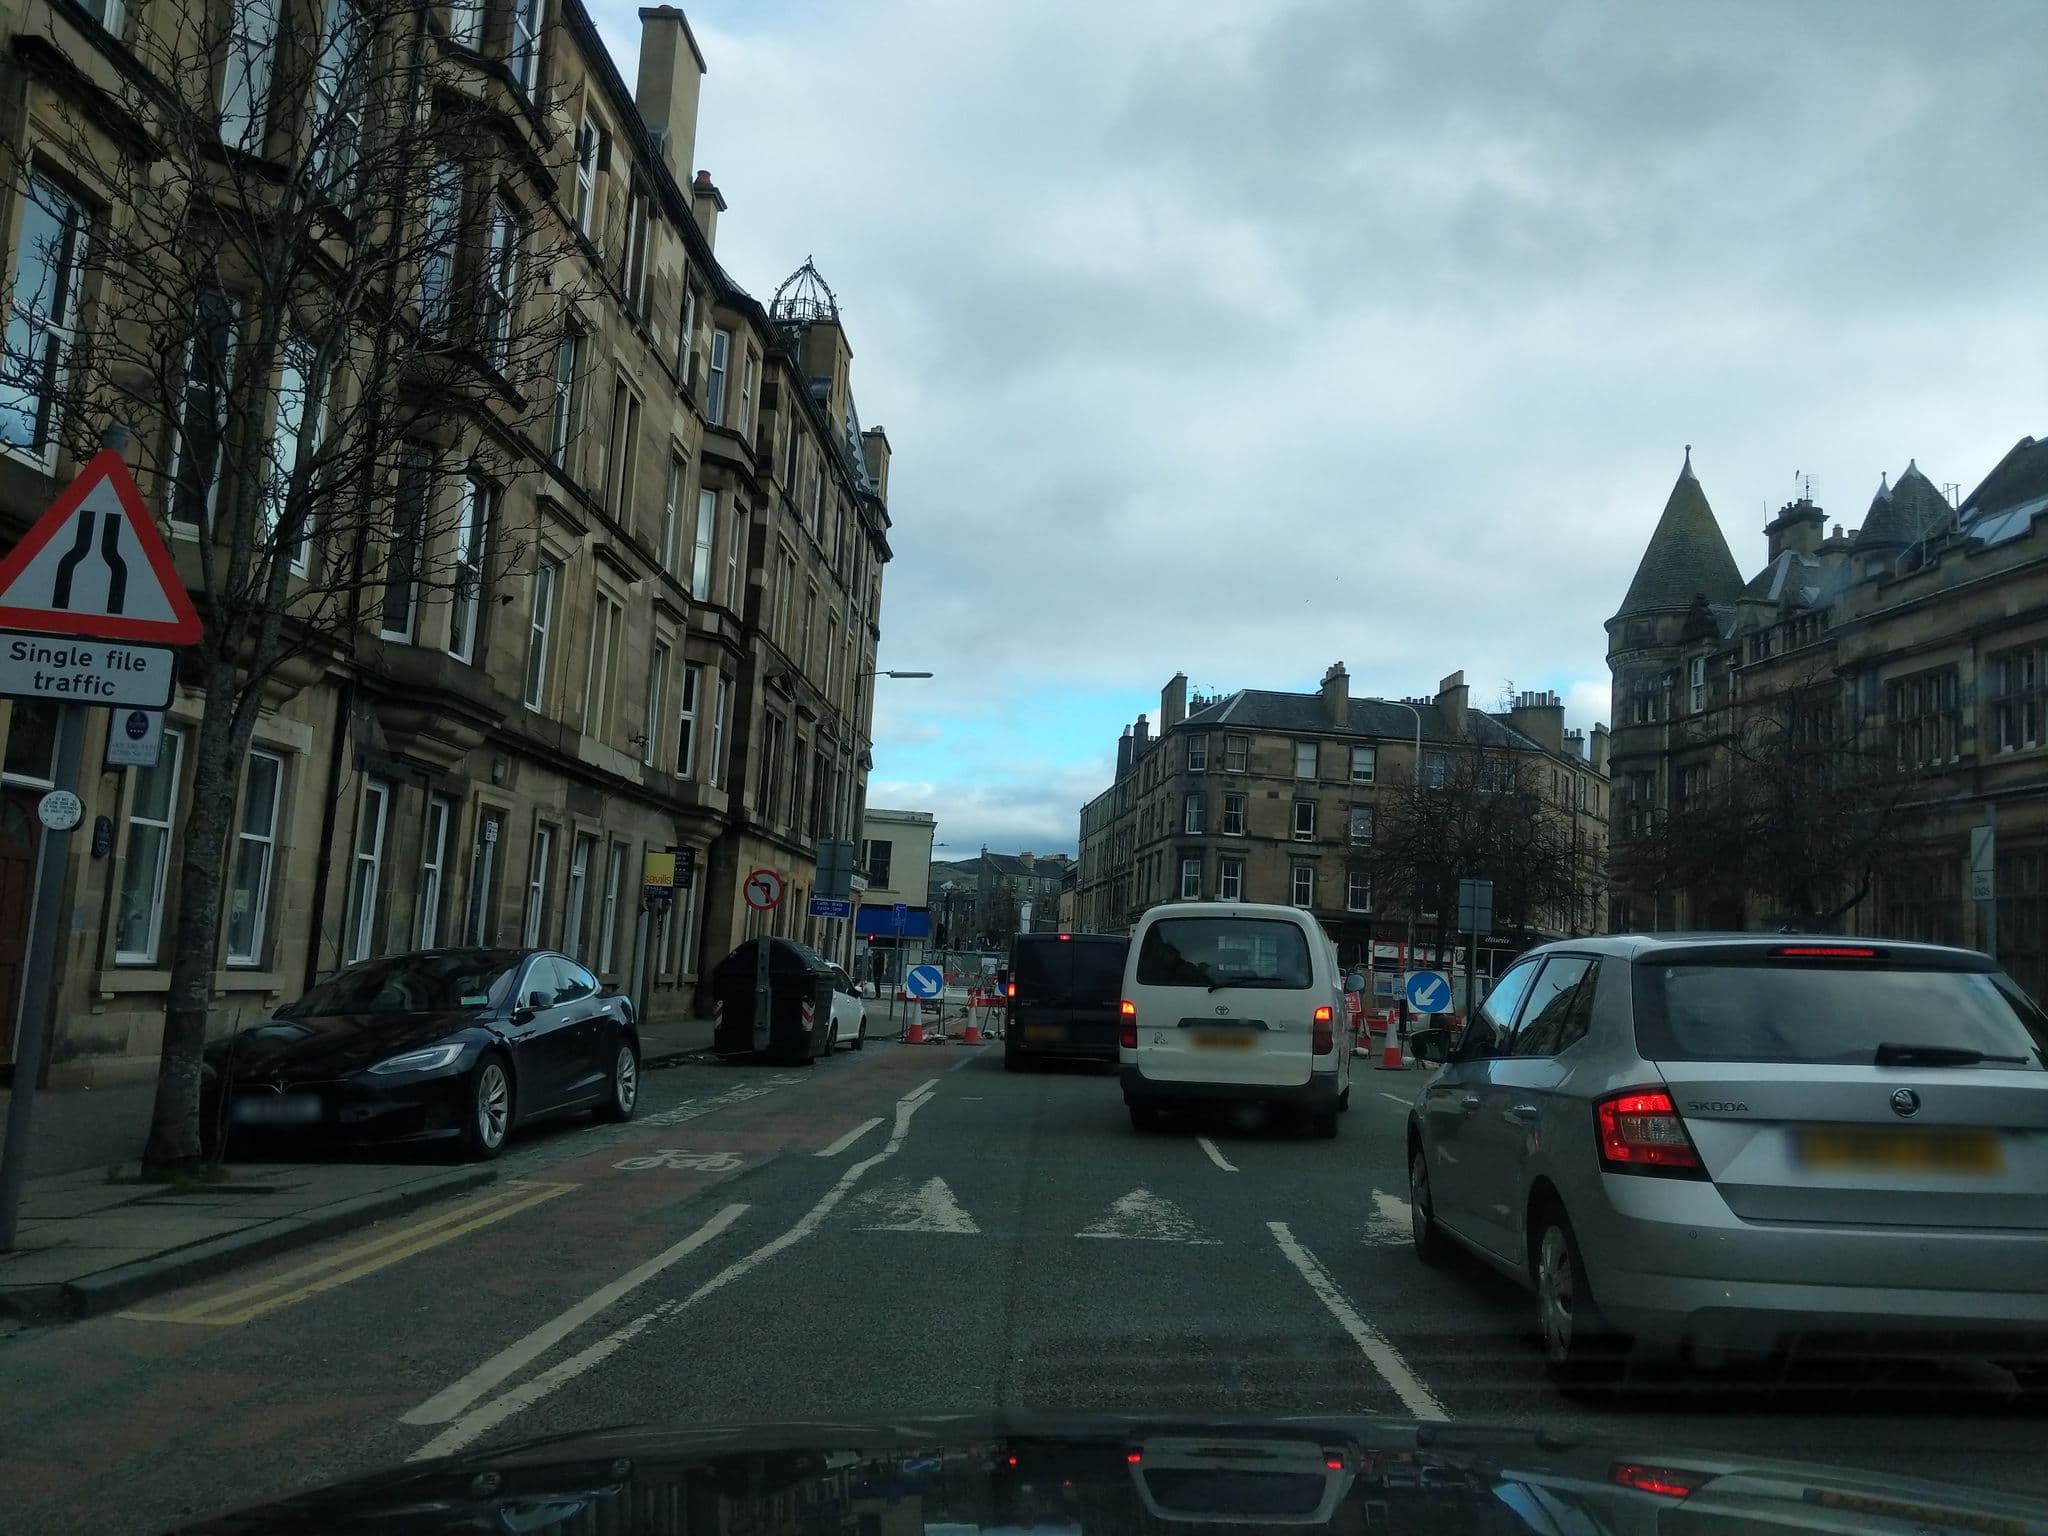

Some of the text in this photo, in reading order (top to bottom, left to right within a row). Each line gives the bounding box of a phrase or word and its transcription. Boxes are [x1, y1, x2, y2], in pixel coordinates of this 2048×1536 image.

[9, 641, 147, 672] Single file
[33, 671, 116, 696] traffic
[643, 873, 673, 885] savills
